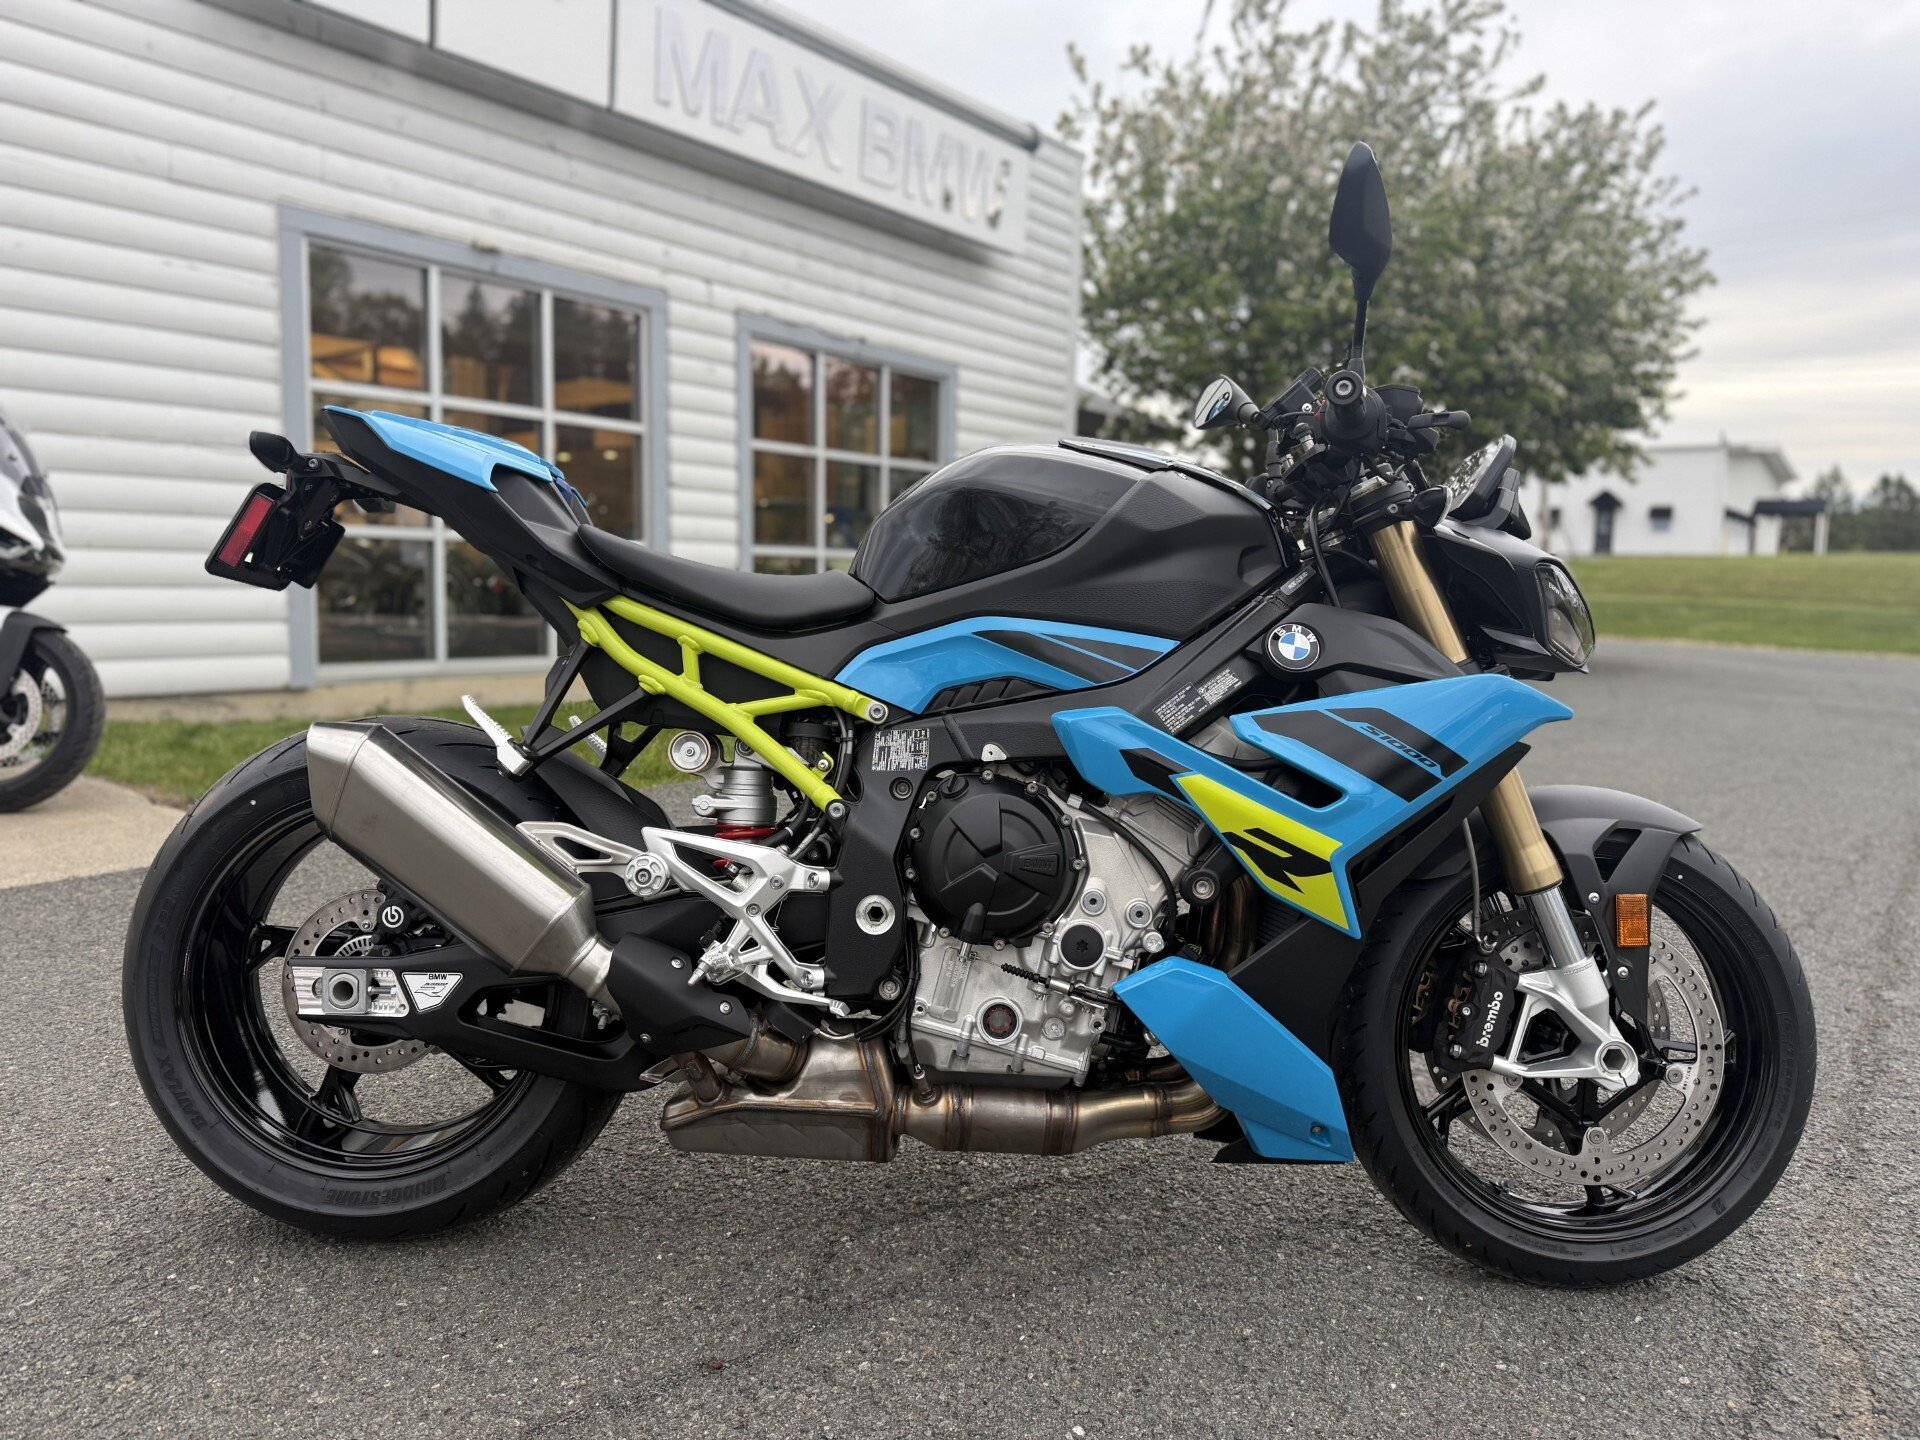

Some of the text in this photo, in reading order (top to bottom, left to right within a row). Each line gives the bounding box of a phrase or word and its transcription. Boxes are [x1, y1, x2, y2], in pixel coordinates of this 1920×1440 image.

[653, 6, 845, 172] MAX
[1275, 624, 1318, 644] BMW
[1361, 724, 1439, 768] S1000
[1476, 991, 1503, 1048] brembo
[324, 1173, 446, 1207] BRIDGESTONE
